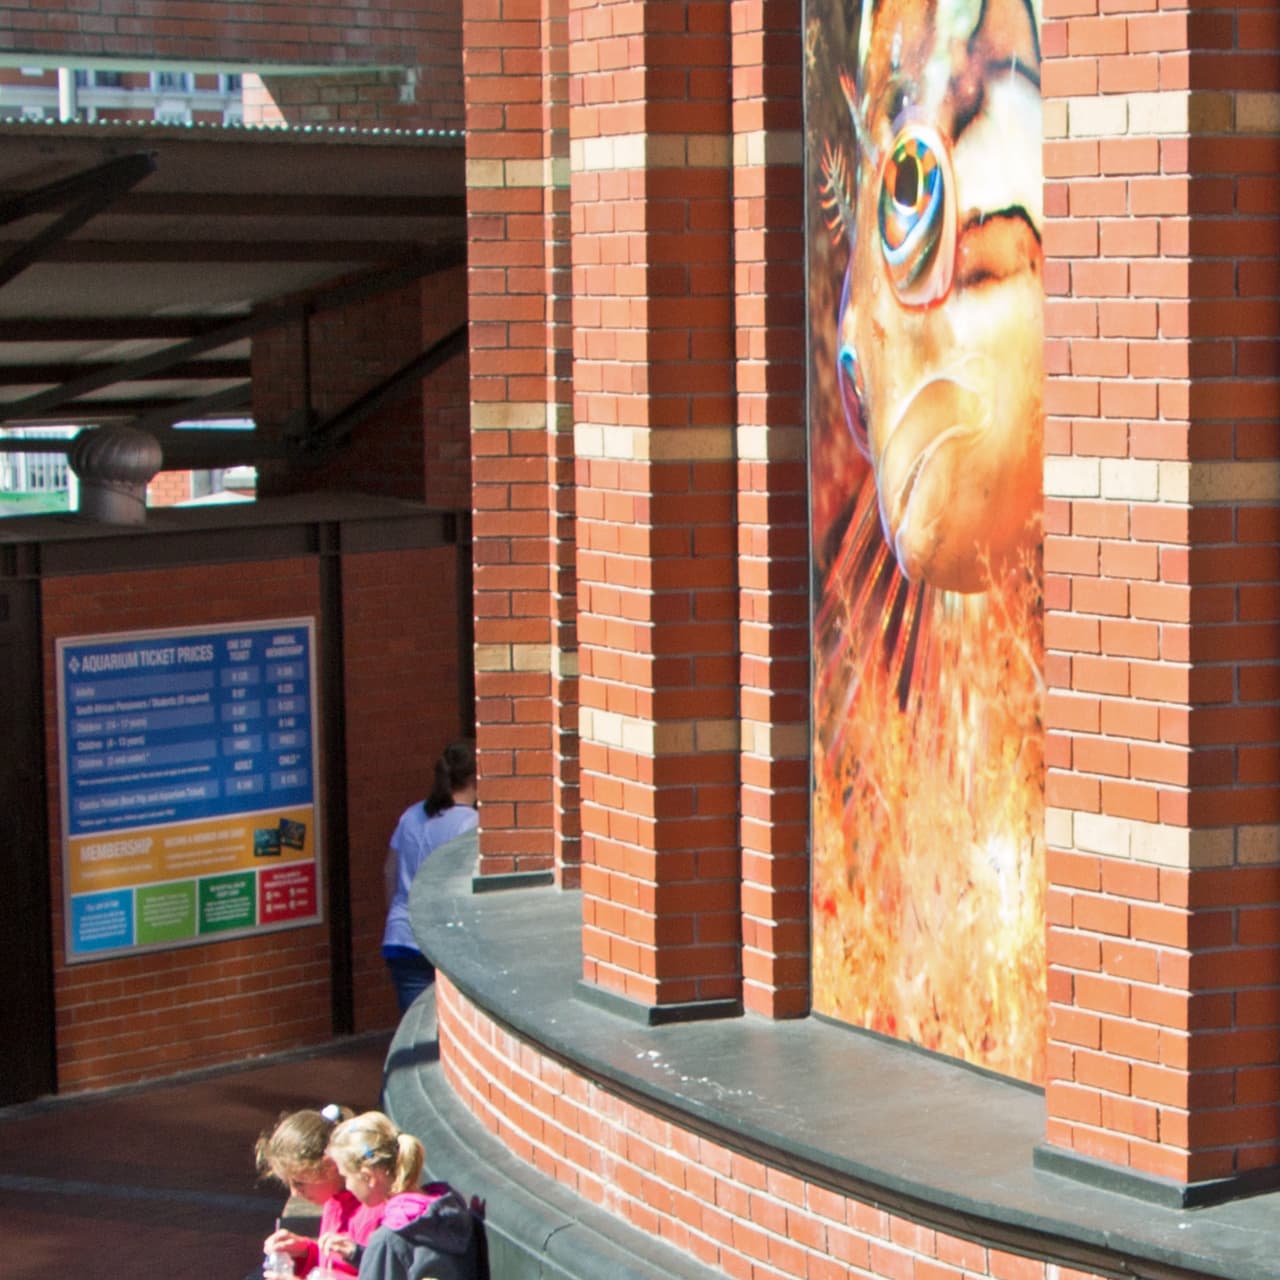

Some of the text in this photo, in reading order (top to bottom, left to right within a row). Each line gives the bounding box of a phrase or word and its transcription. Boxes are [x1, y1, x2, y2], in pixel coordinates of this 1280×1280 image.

[82, 644, 214, 673] AQUARIUM TICKET PRICES
[80, 837, 153, 862] MEMBERSHIP
